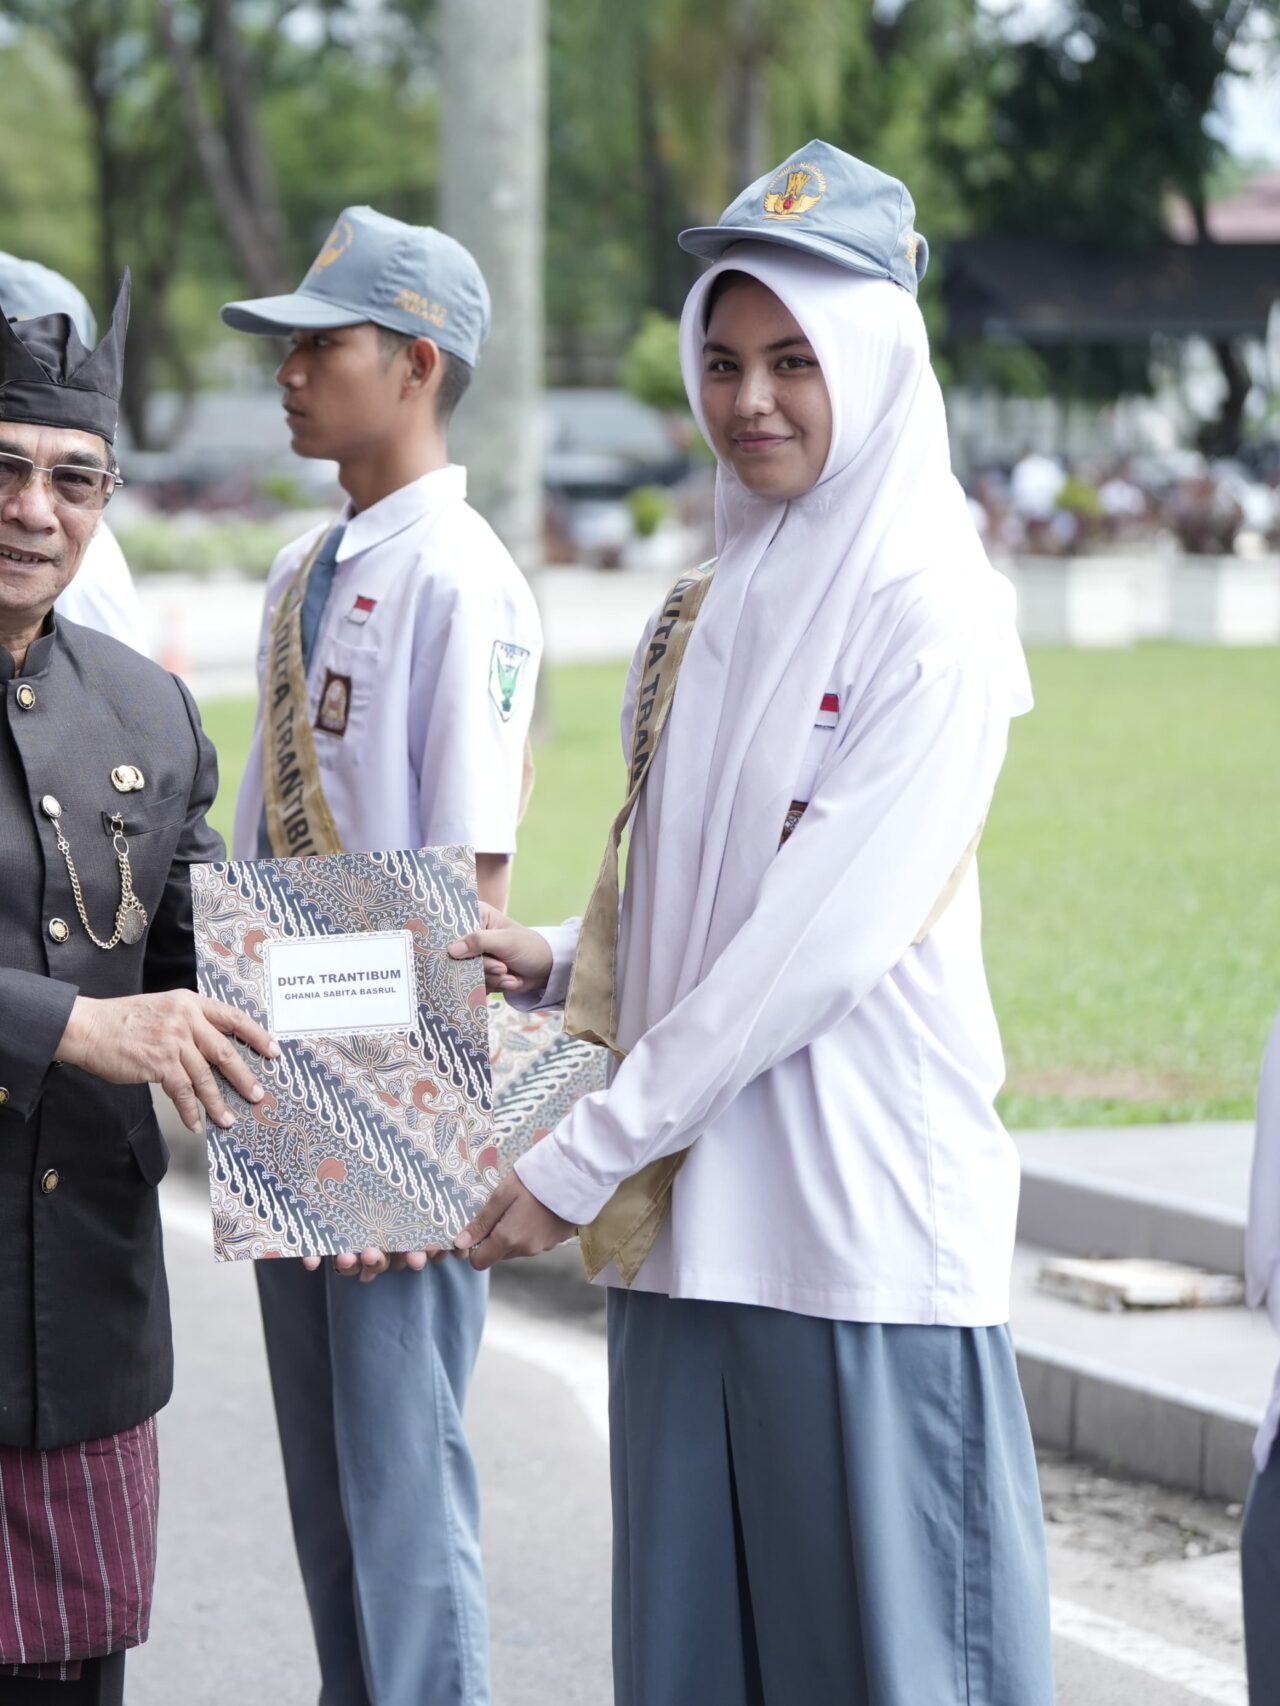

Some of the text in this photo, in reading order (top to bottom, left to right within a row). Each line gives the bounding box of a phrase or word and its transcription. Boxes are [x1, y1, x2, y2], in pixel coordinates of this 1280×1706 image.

[276, 706, 318, 857] TRANTIBU
[278, 969, 402, 987] DUTA TRANTIBUM
[284, 987, 397, 1001] GHANIA SABITA BASRUL
